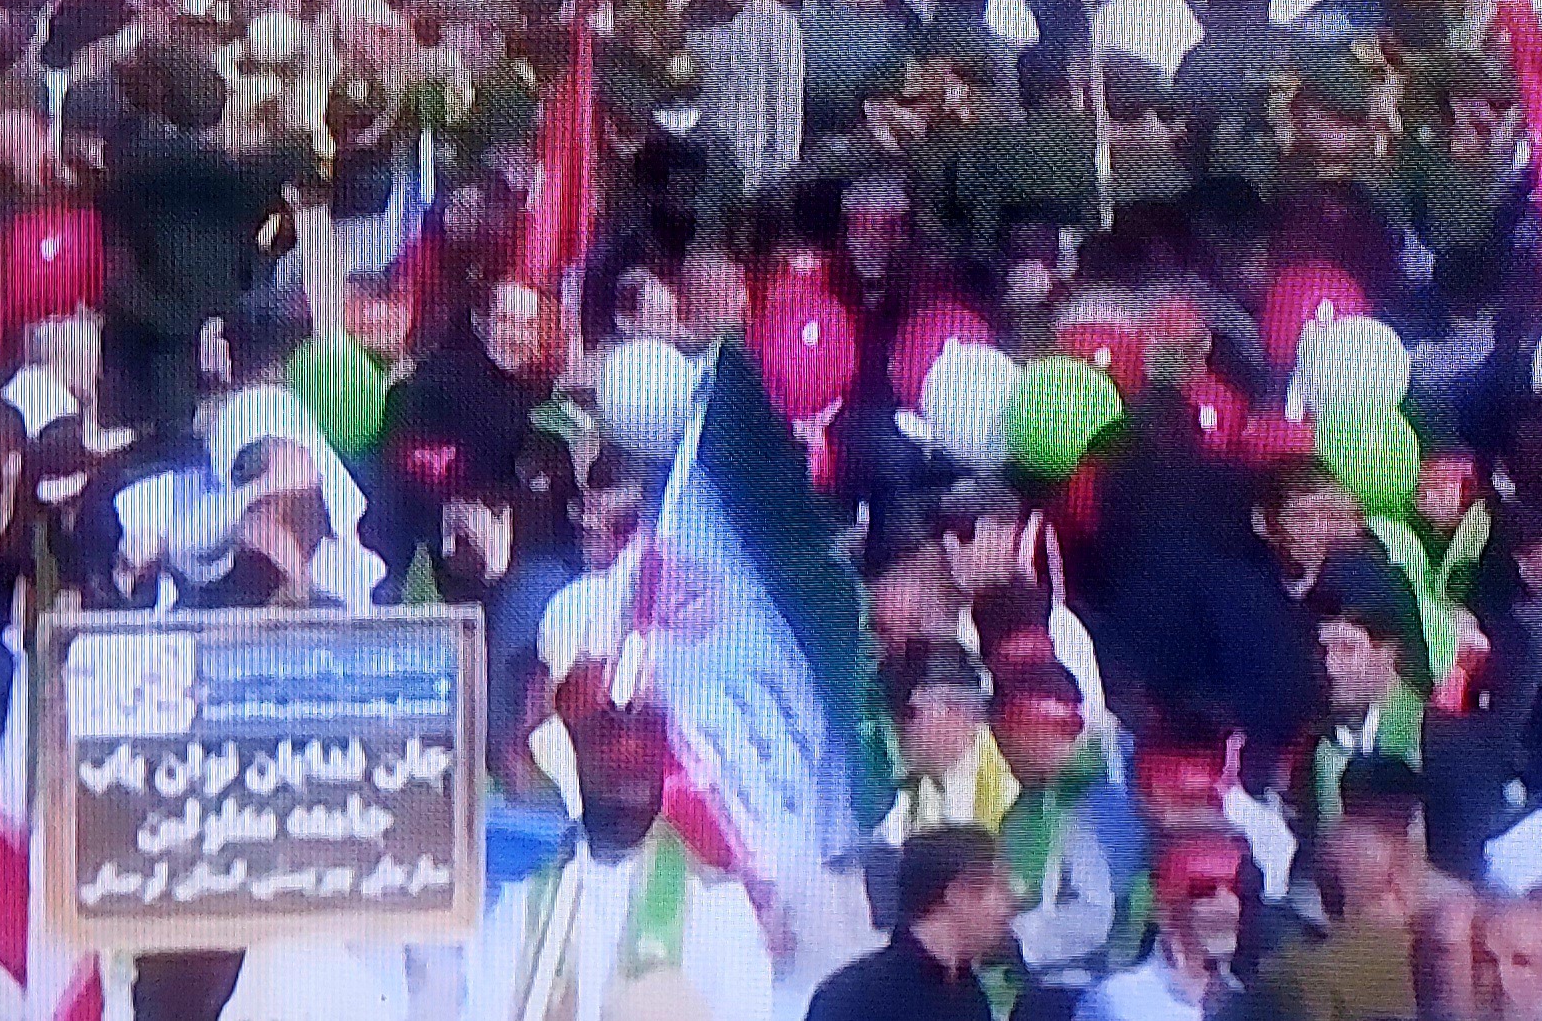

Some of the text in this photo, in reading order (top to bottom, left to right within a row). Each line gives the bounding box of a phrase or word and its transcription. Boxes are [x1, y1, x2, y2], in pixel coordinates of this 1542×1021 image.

[245, 739, 366, 795] فدایان
[373, 737, 451, 793] جان
[137, 793, 394, 855] جامعه معلولین
